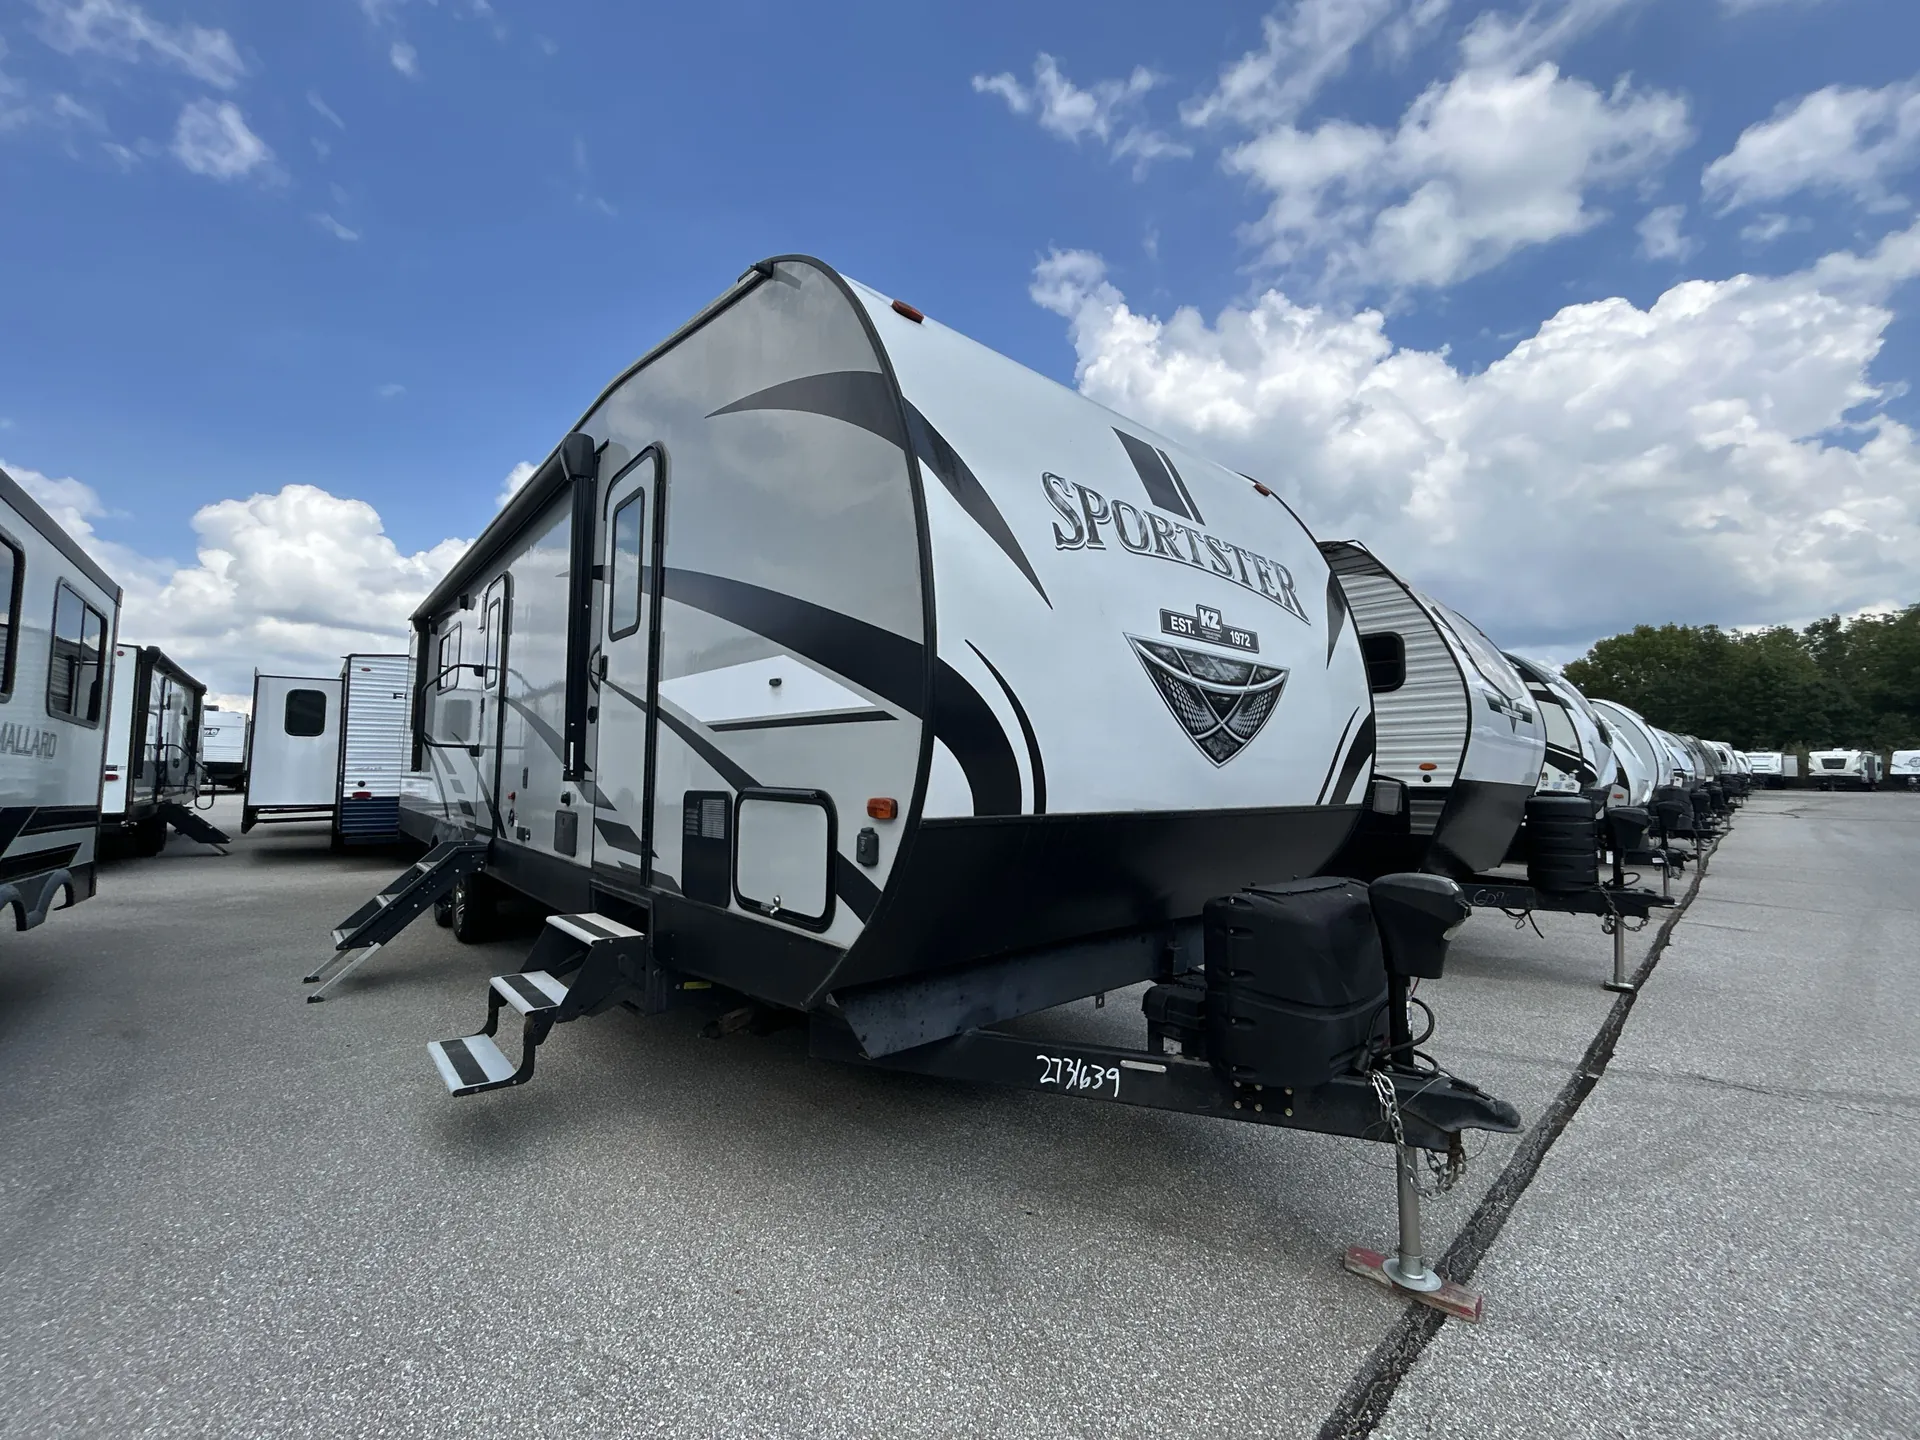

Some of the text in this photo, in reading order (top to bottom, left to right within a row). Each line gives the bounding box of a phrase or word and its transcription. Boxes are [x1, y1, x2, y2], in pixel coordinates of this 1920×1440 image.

[1041, 471, 1311, 626] SPORTSTER
[1170, 615, 1195, 635] EST.
[1199, 608, 1221, 630] KZ
[1229, 630, 1251, 647] 1972
